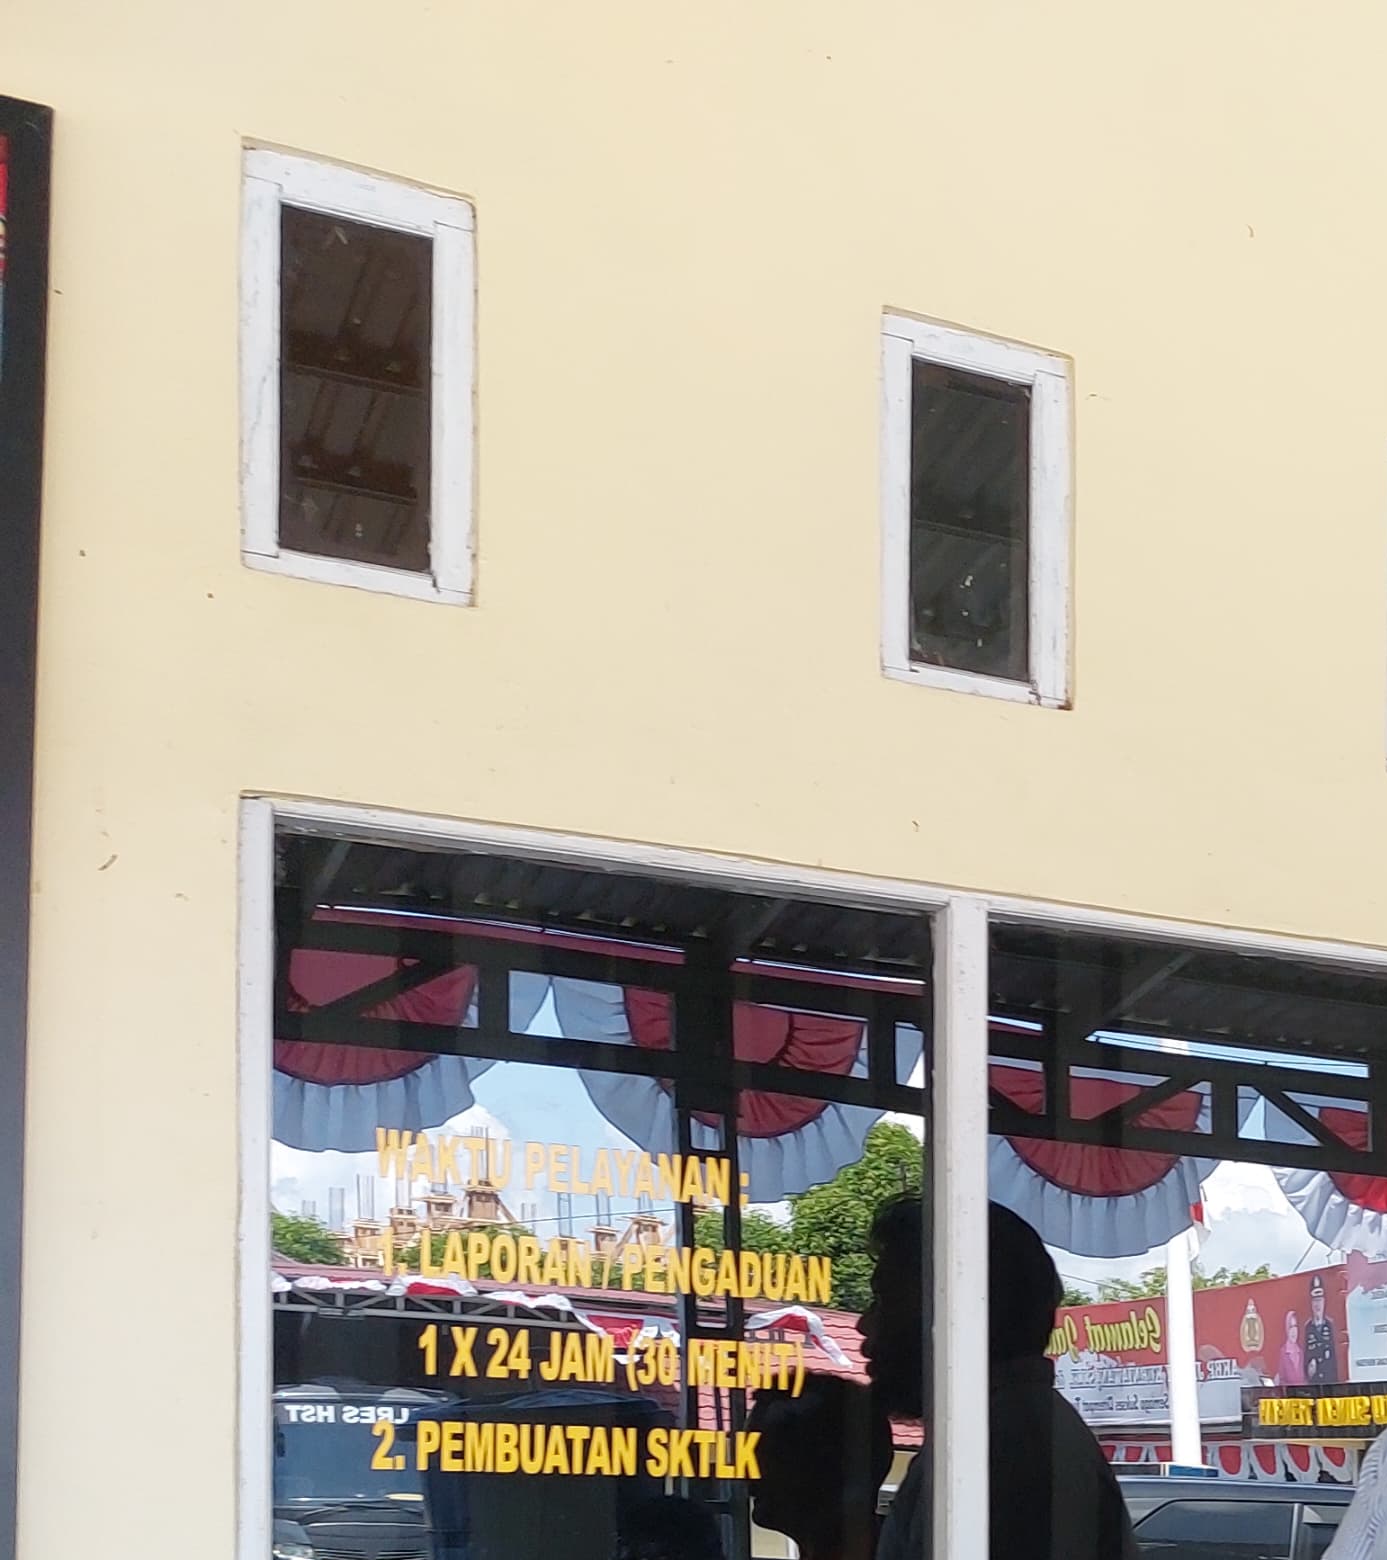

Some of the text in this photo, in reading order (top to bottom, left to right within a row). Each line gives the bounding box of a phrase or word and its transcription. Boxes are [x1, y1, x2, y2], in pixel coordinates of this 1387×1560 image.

[375, 1127, 512, 1190] WAKTU
[524, 1140, 731, 1207] PELAYANAN
[379, 1228, 405, 1277] 1.
[418, 1230, 591, 1289] LAPORAN
[622, 1243, 832, 1304] PENGADUAN
[417, 1324, 805, 1398] 1 X 24 JAM (30 MENIT)
[371, 1420, 762, 1480] 2. PEMBUATAN SKTLK
